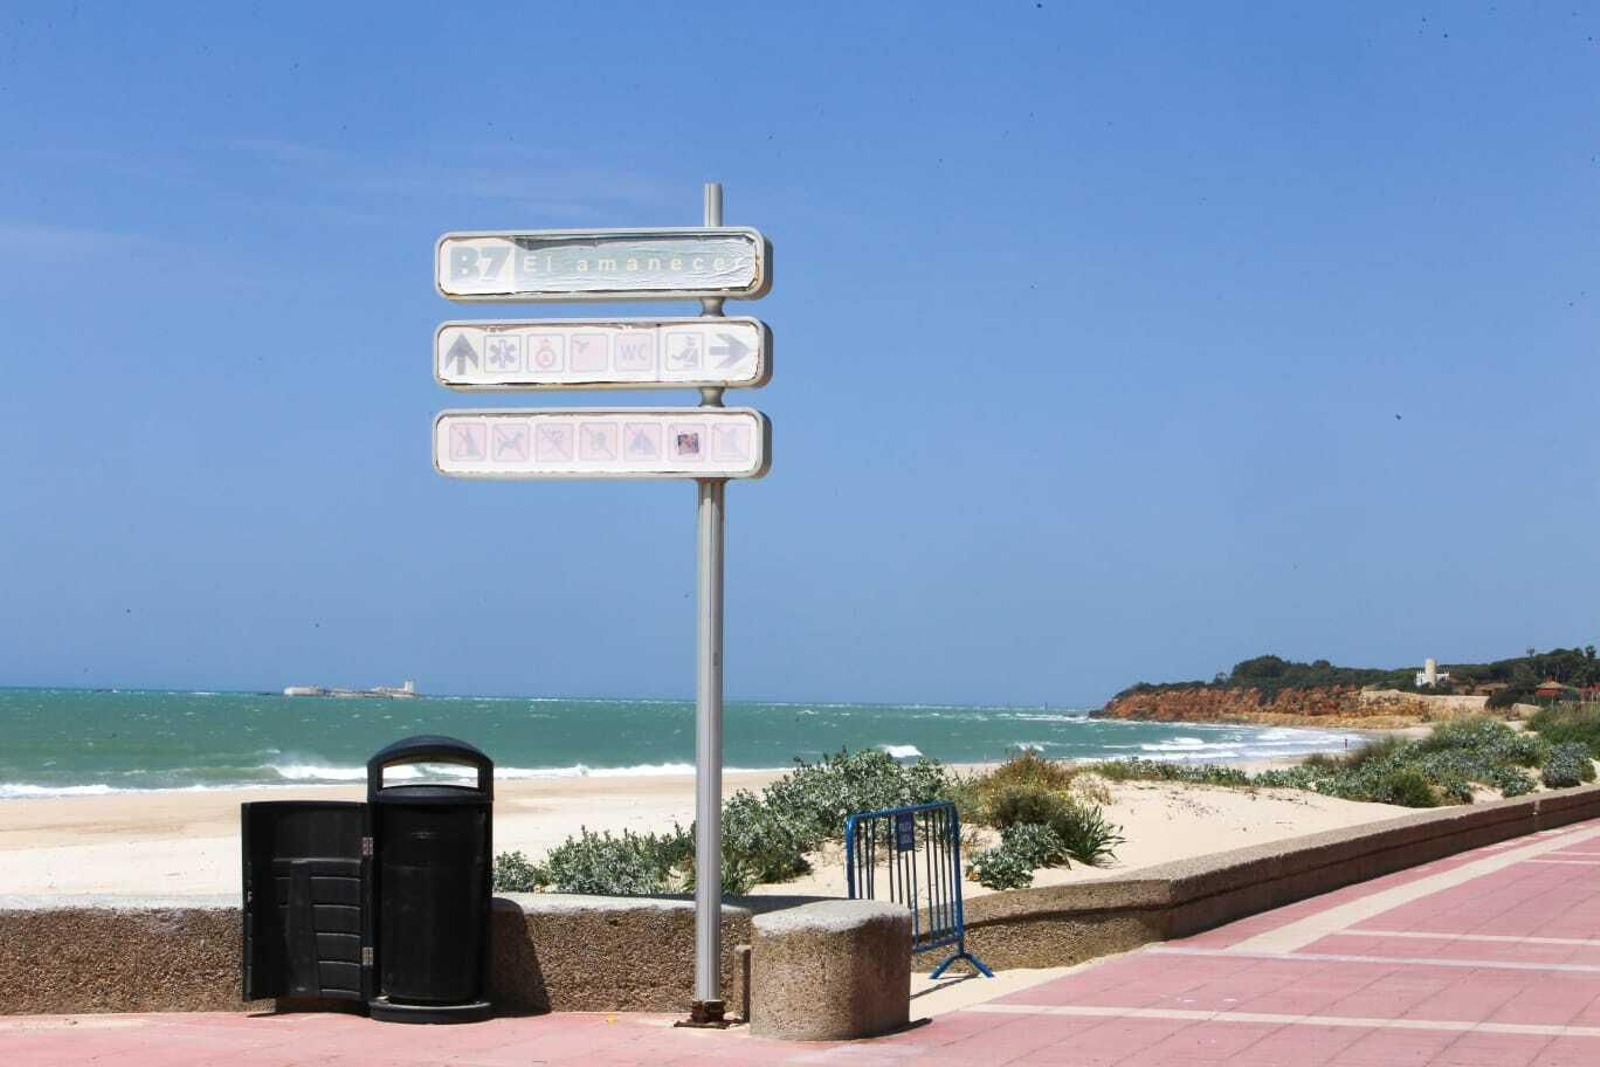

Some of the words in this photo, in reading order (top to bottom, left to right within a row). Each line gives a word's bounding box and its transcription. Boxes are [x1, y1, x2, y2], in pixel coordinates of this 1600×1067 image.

[450, 246, 512, 281] B7
[523, 255, 552, 272] El
[620, 344, 648, 361] WC
